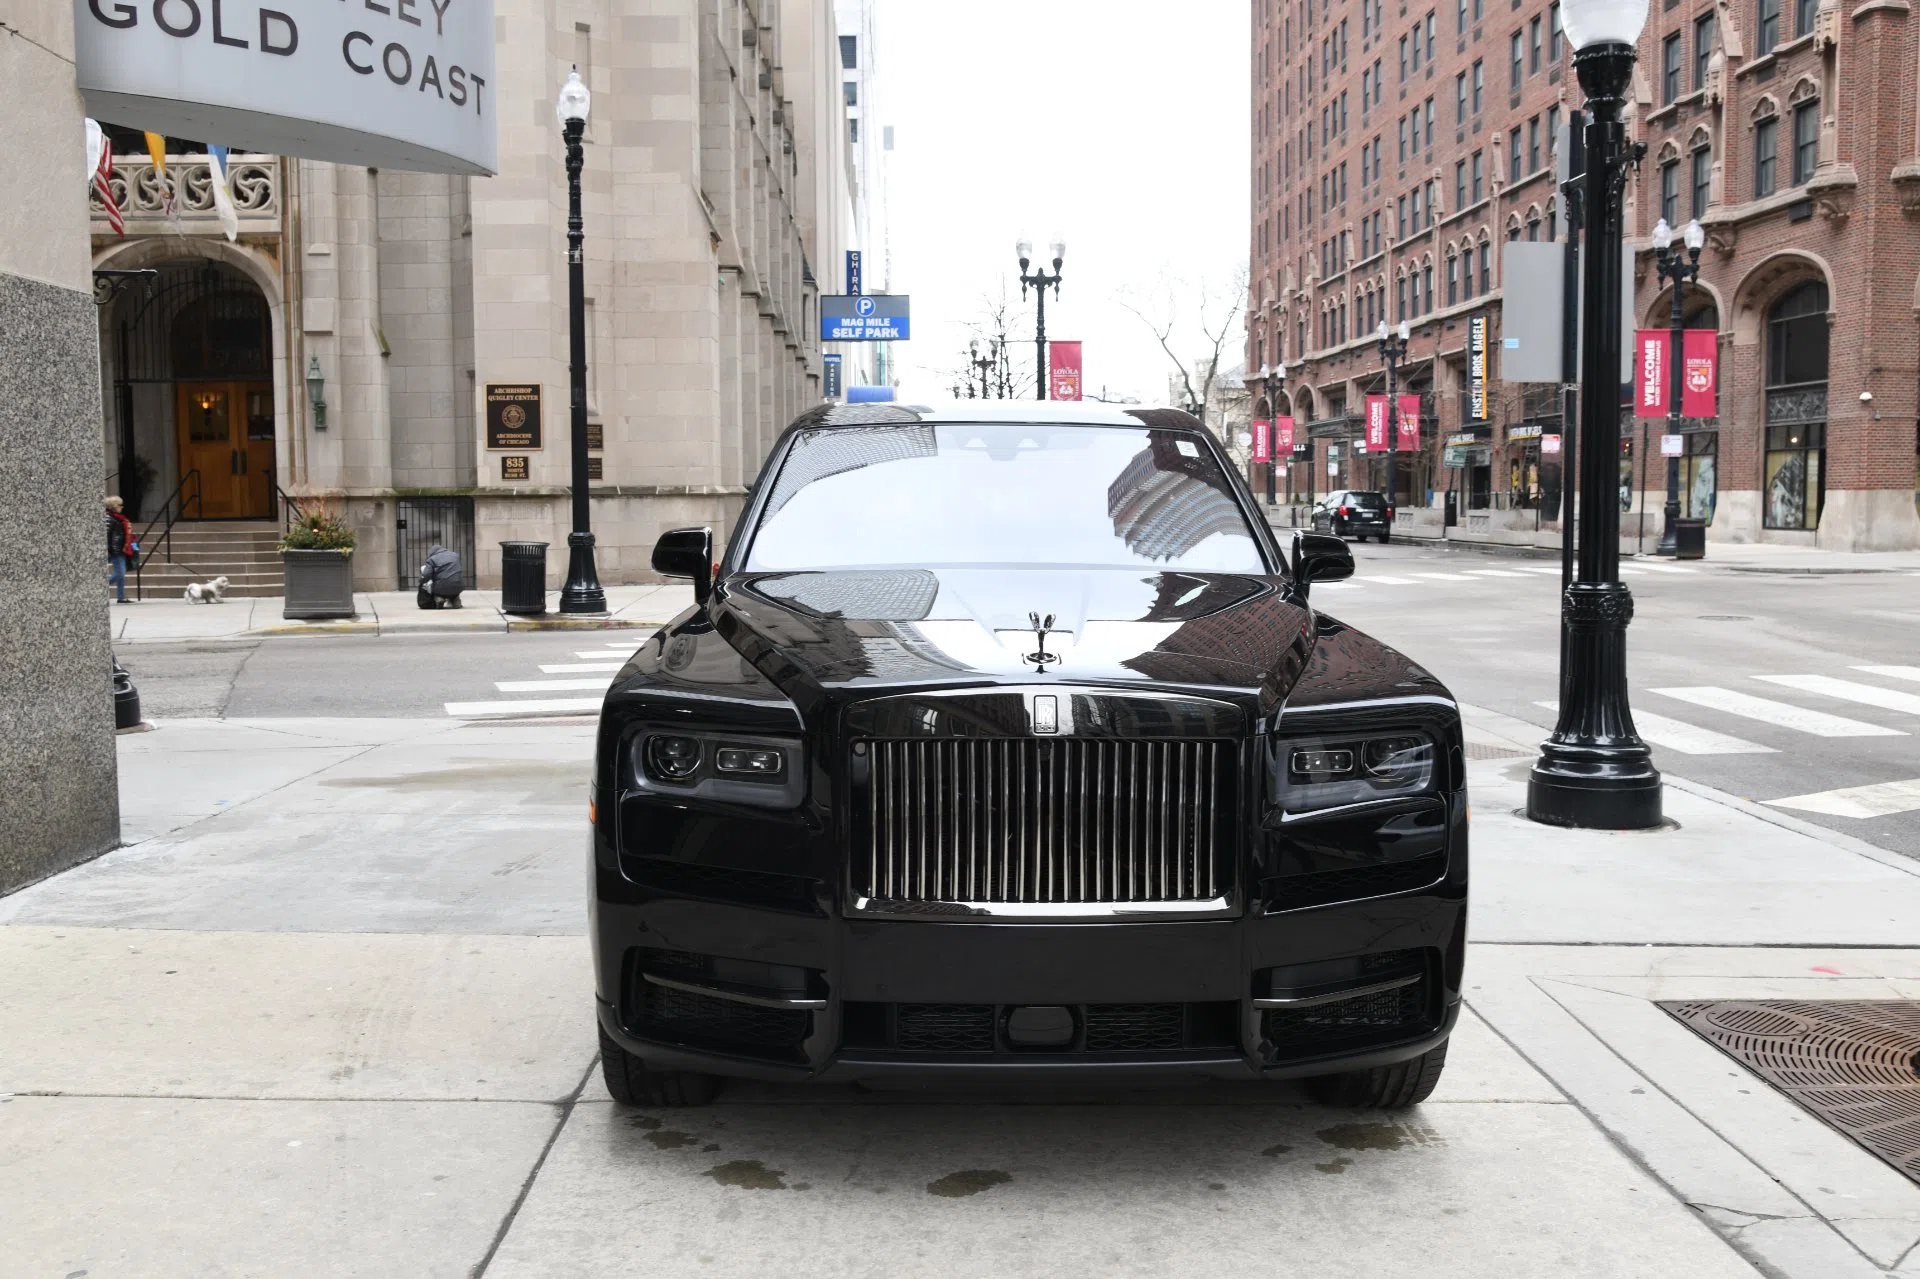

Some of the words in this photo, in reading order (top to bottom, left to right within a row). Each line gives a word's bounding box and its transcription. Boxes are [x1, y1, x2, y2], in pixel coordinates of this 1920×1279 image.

[88, 0, 299, 57] GOLD
[342, 30, 486, 116] COAST
[851, 253, 859, 295] GHIRA
[832, 327, 863, 338] SELF
[865, 327, 900, 338] PARK
[841, 318, 865, 327] MAG
[866, 318, 890, 327] MILE
[1472, 318, 1484, 352] BAGELS
[1053, 367, 1079, 375] LOYOLA
[1644, 340, 1655, 407] WELCOME
[1472, 378, 1483, 418] EINSTEIN
[1371, 402, 1379, 444] WELCOME
[506, 457, 524, 468] 835
